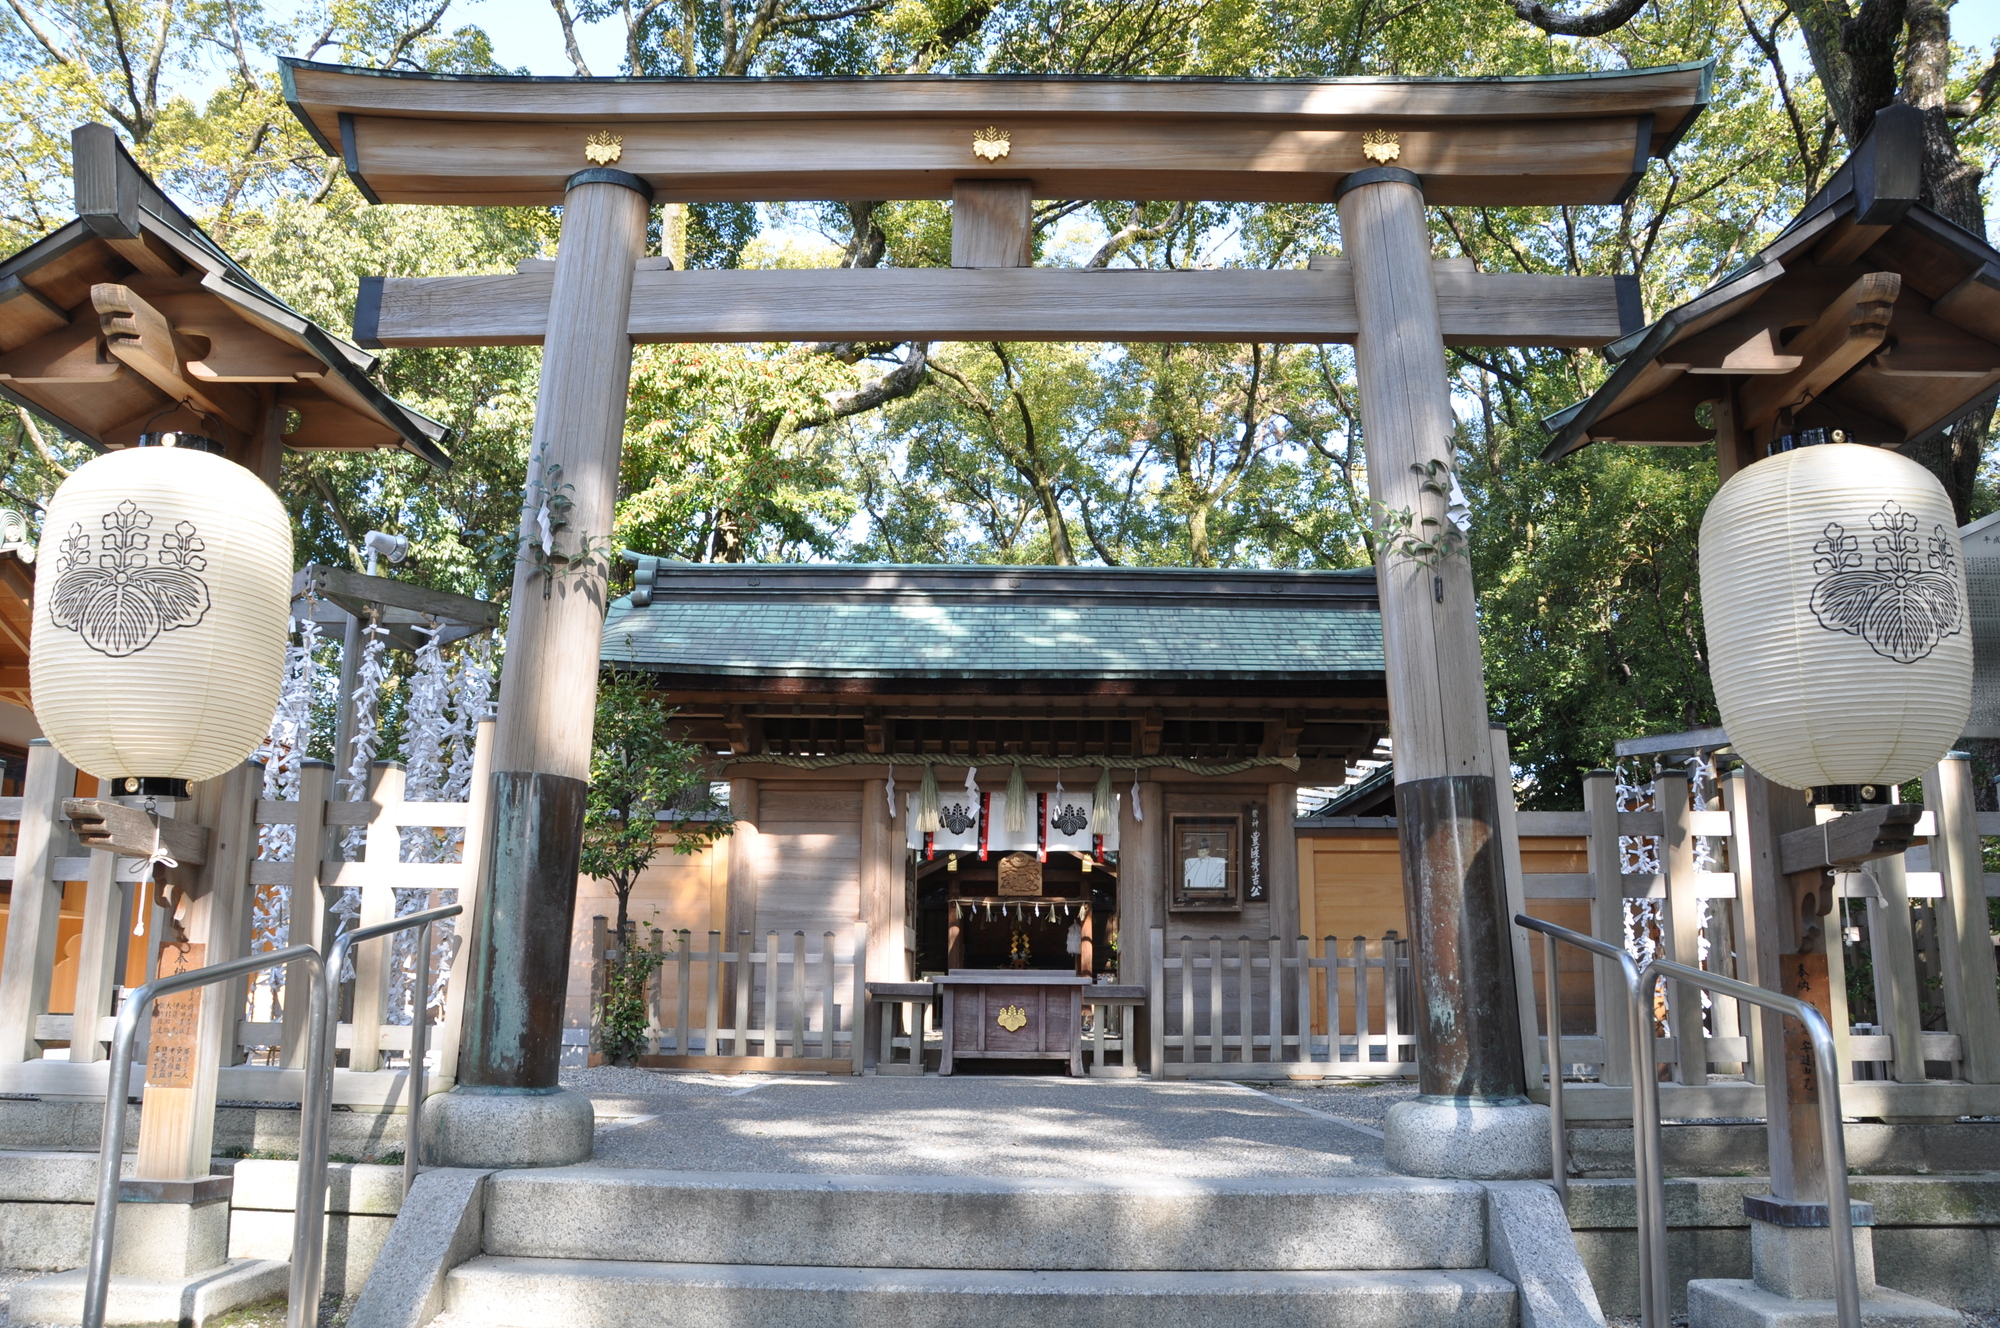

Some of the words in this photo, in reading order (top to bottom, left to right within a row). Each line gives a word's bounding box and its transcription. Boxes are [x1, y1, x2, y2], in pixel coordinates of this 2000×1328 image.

[1250, 830, 1263, 898] 豊臣秀吉公
[1796, 963, 1811, 992] 奉納
